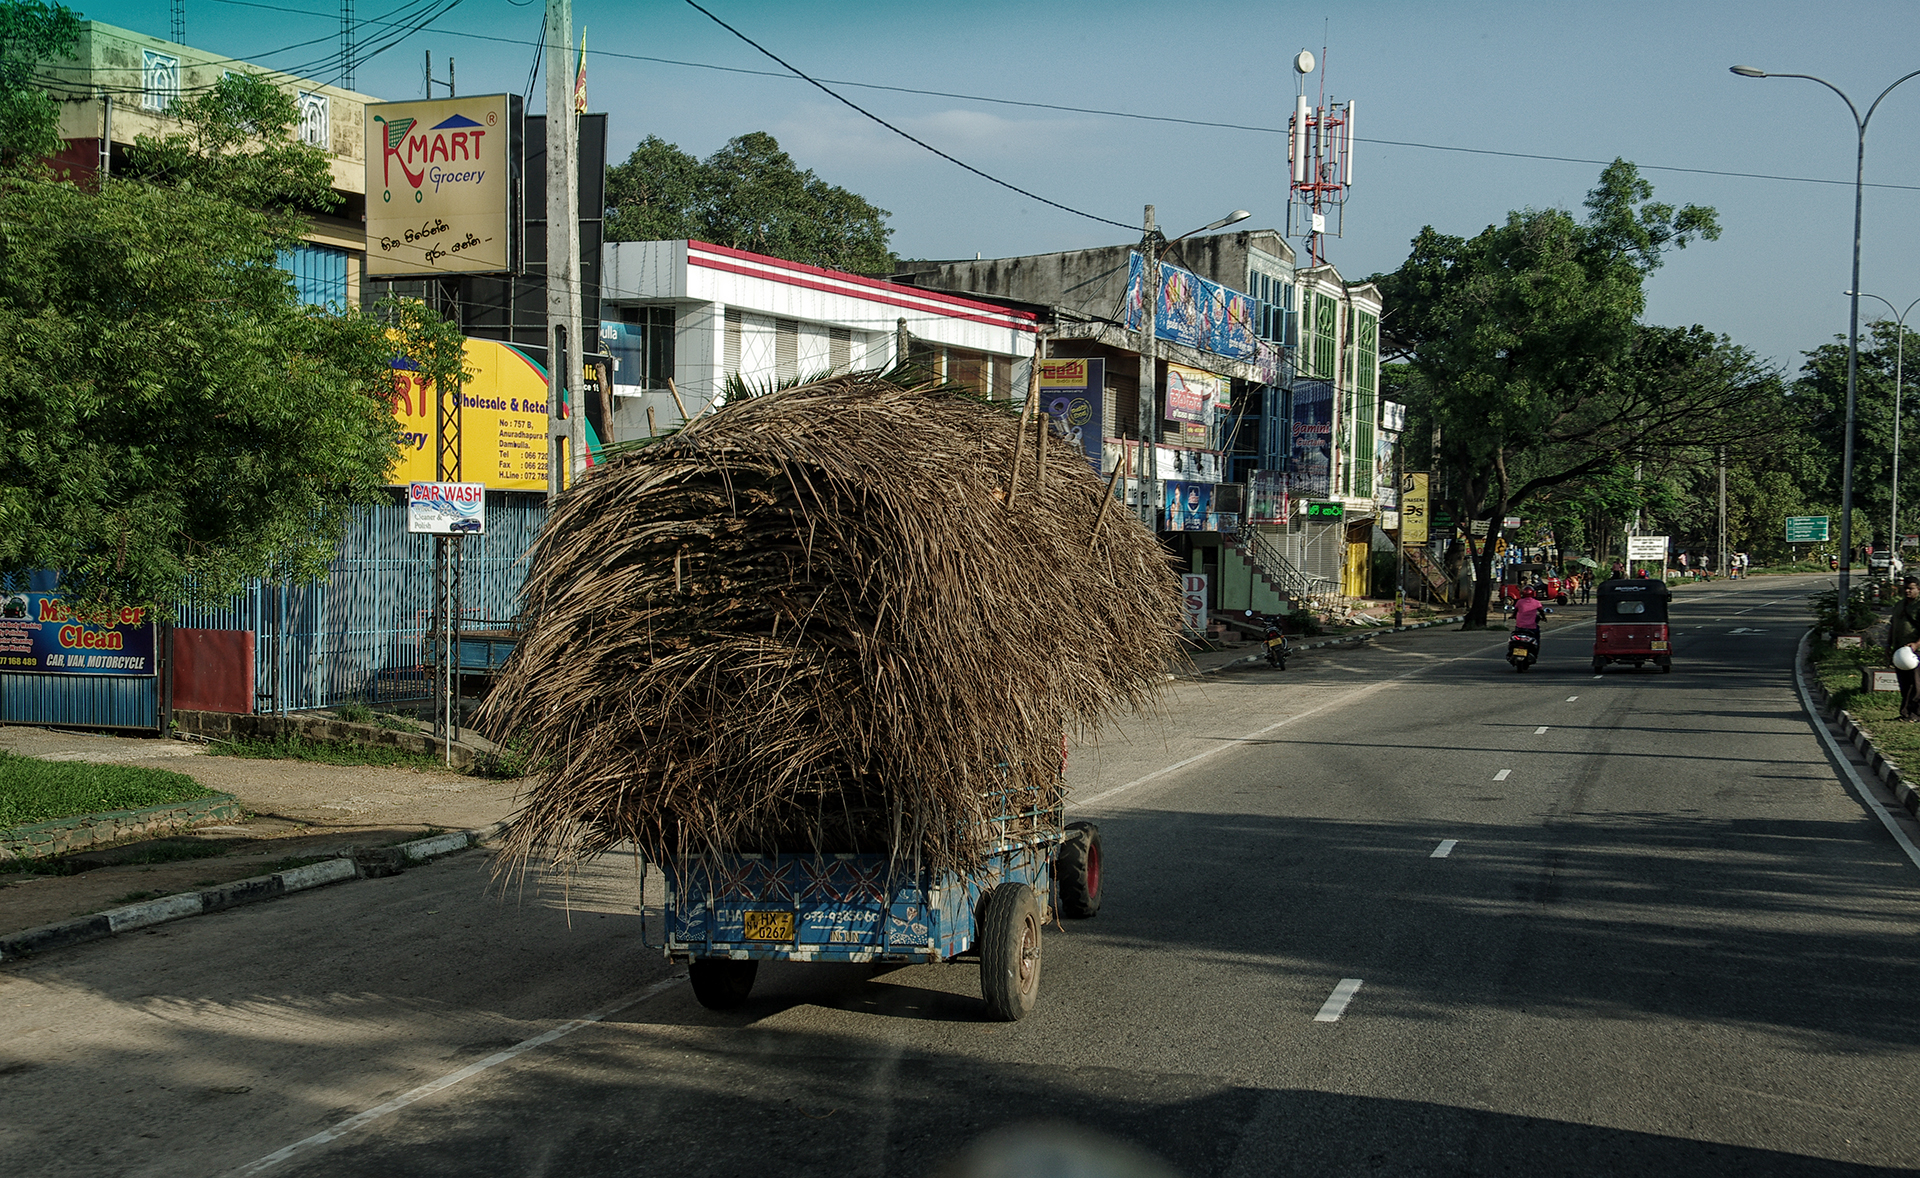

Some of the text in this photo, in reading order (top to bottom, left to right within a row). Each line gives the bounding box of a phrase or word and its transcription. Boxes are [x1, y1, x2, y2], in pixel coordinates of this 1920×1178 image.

[429, 166, 485, 193] Grocery
[510, 397, 519, 412] &
[522, 399, 549, 414] Retai
[499, 419, 509, 428] No
[513, 420, 526, 428] 757
[1292, 421, 1331, 437] Gamini
[499, 429, 543, 440] Anuradhapura
[499, 450, 509, 458] Tel
[524, 451, 536, 460] 066
[499, 460, 511, 469] Fax
[524, 471, 536, 480] 072
[412, 484, 482, 502] CAR WASH
[58, 624, 123, 650] Clean
[8, 657, 21, 666] 168
[22, 657, 37, 666] 489
[46, 653, 145, 670] CAR, VAN, MOTORCYCLE
[761, 913, 777, 926] HX
[759, 926, 786, 939] 0267
